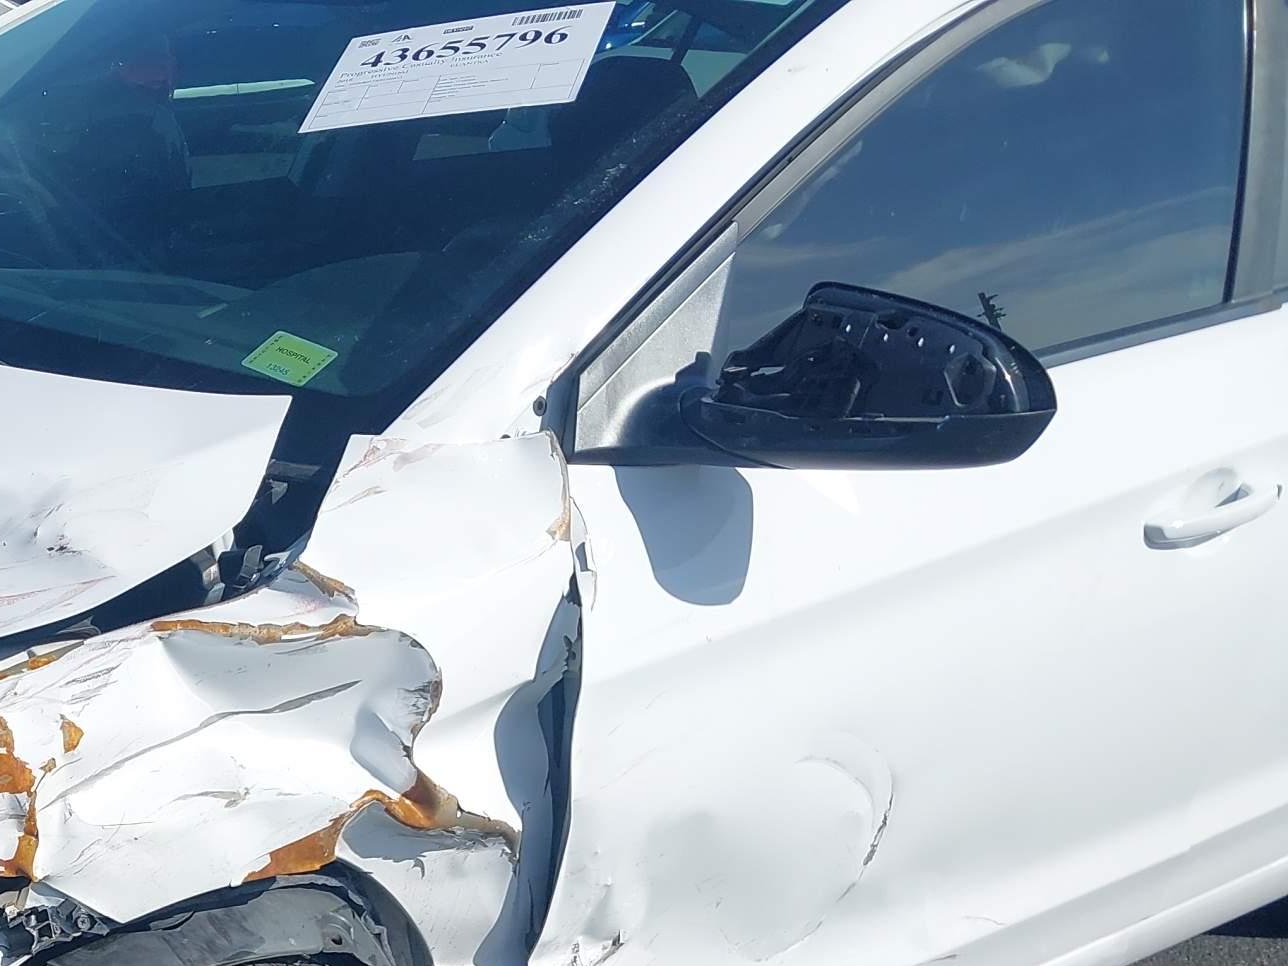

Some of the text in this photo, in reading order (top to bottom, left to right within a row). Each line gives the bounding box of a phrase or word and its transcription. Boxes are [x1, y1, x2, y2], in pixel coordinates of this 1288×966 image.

[360, 24, 572, 69] 43655796
[339, 65, 399, 79] Progressive
[451, 51, 503, 63] Insurance
[275, 346, 312, 365] HOSPITAL
